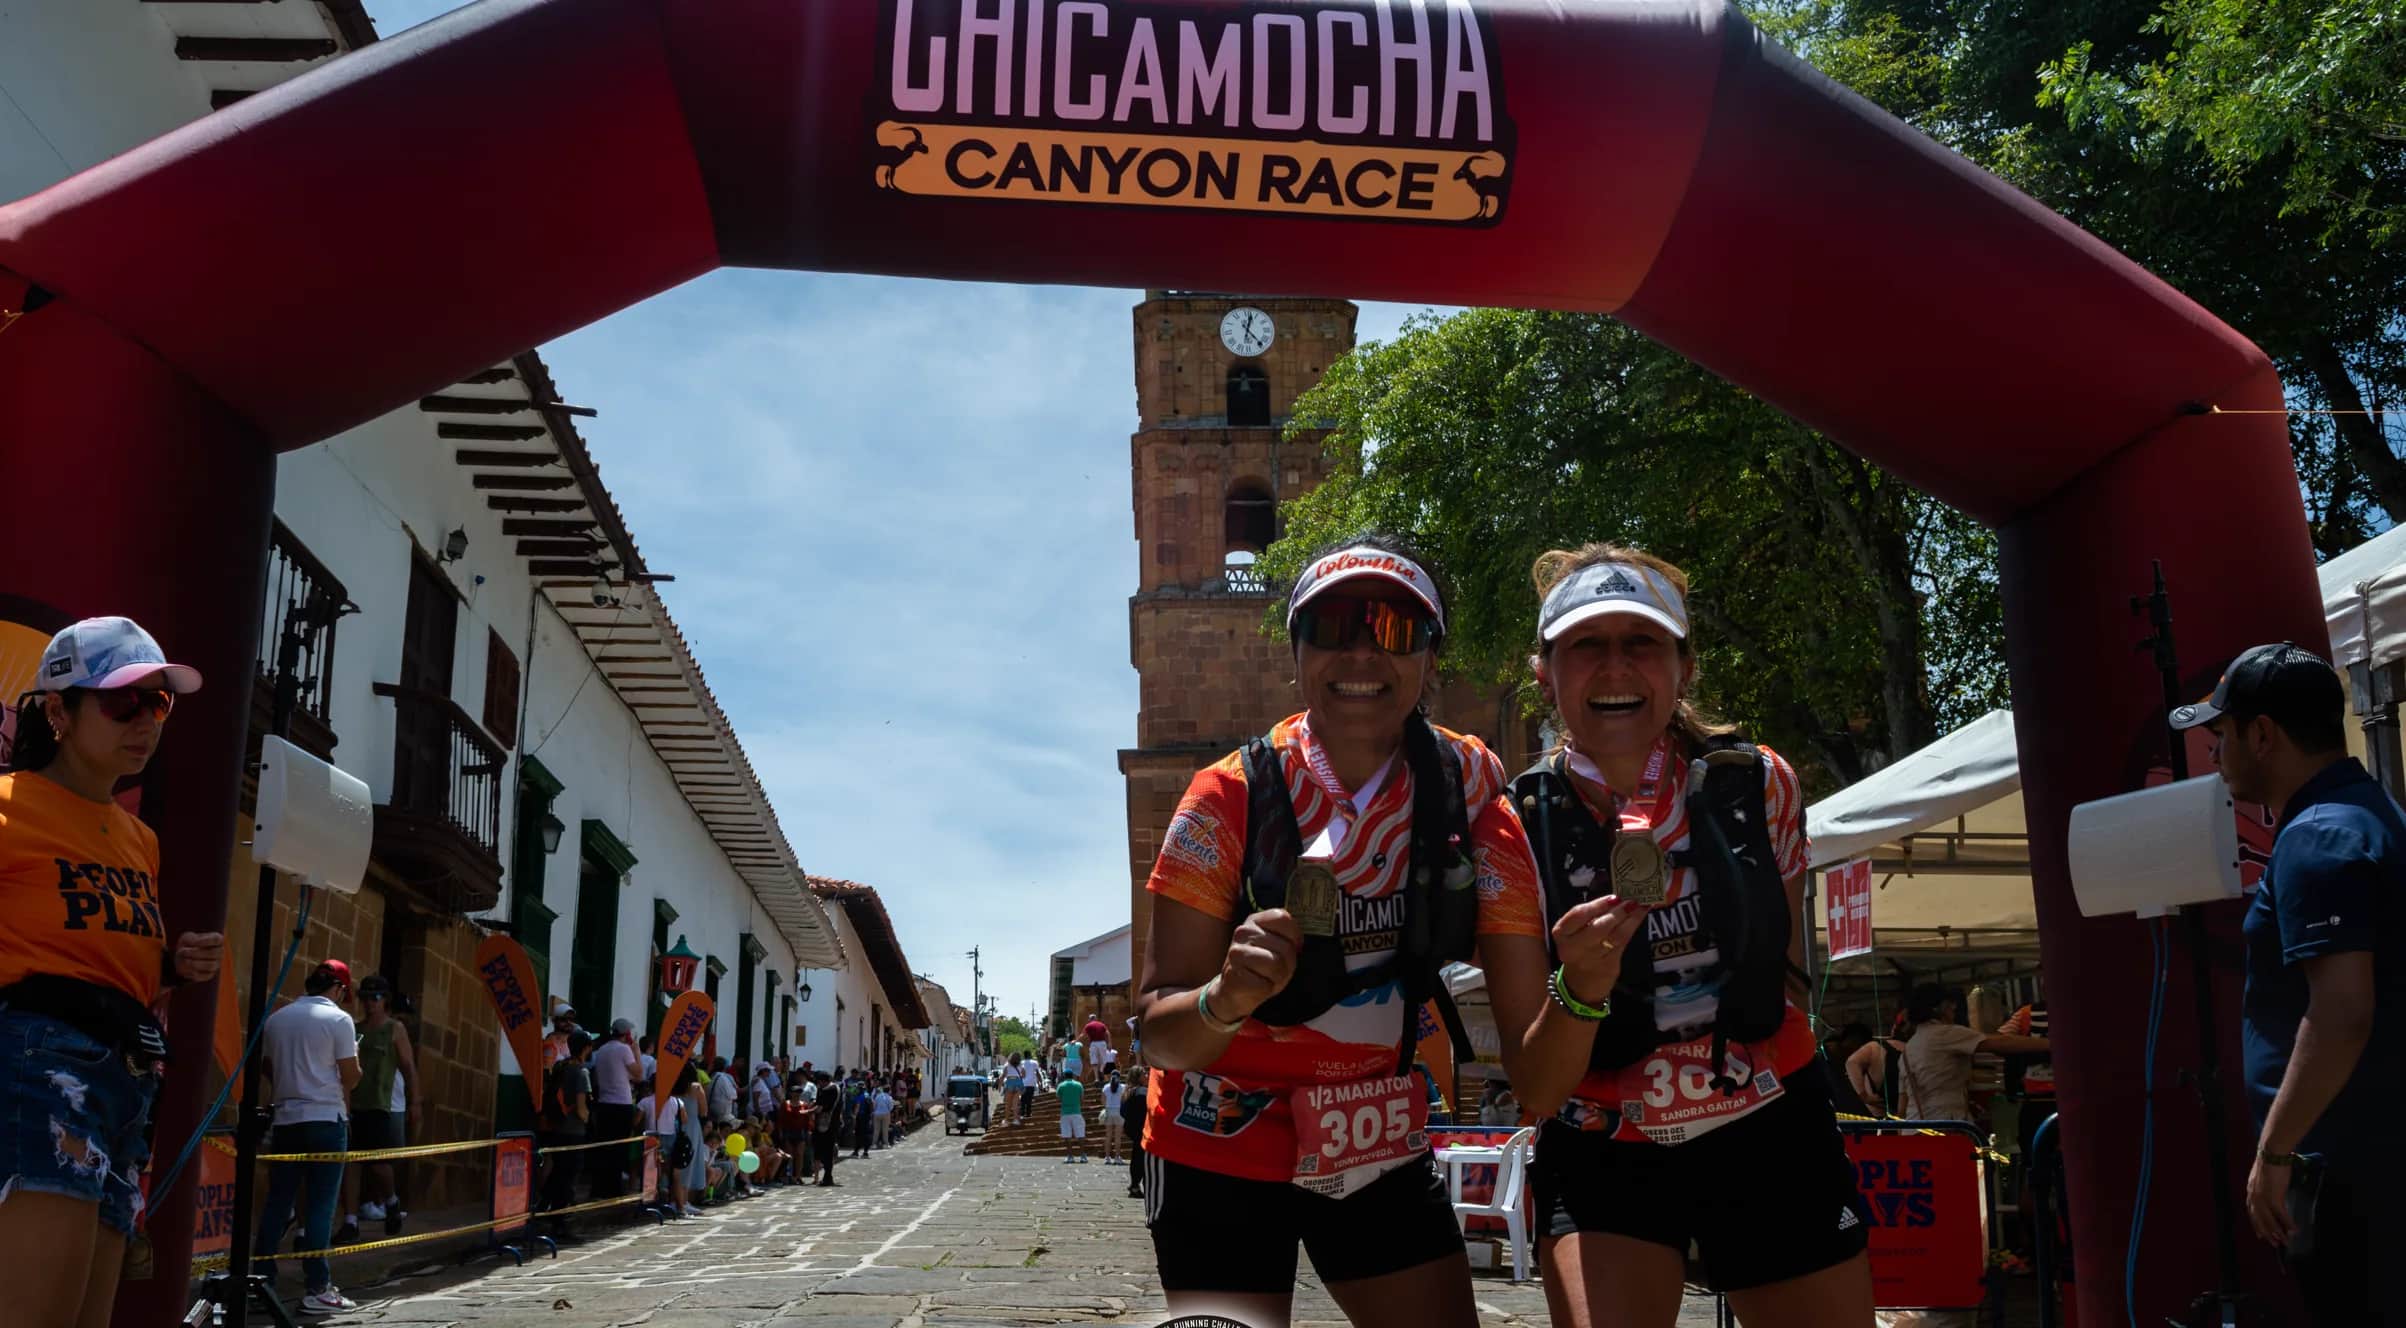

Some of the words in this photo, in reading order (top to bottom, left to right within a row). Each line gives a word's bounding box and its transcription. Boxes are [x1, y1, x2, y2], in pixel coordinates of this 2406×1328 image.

[891, 0, 1494, 142] CHICAMOCHA
[944, 138, 1241, 201] CANYON
[1258, 151, 1439, 211] RACE
[1316, 554, 1417, 581] Colombia
[55, 857, 158, 903] PEOPL
[60, 891, 164, 939] PLAY
[1344, 934, 1394, 953] ANYON
[1307, 1084, 1334, 1111] 1/2
[1335, 1073, 1414, 1104] MARATON
[1183, 1104, 1217, 1122] AÑOS
[1659, 1105, 1706, 1123] SANDRA
[1706, 1096, 1748, 1114] GAITAN
[1320, 1096, 1412, 1159] 305
[1856, 1159, 1933, 1189] PLE
[194, 1184, 237, 1209] OPLE
[1857, 1193, 1936, 1227] AYS
[193, 1208, 235, 1238] AYS
